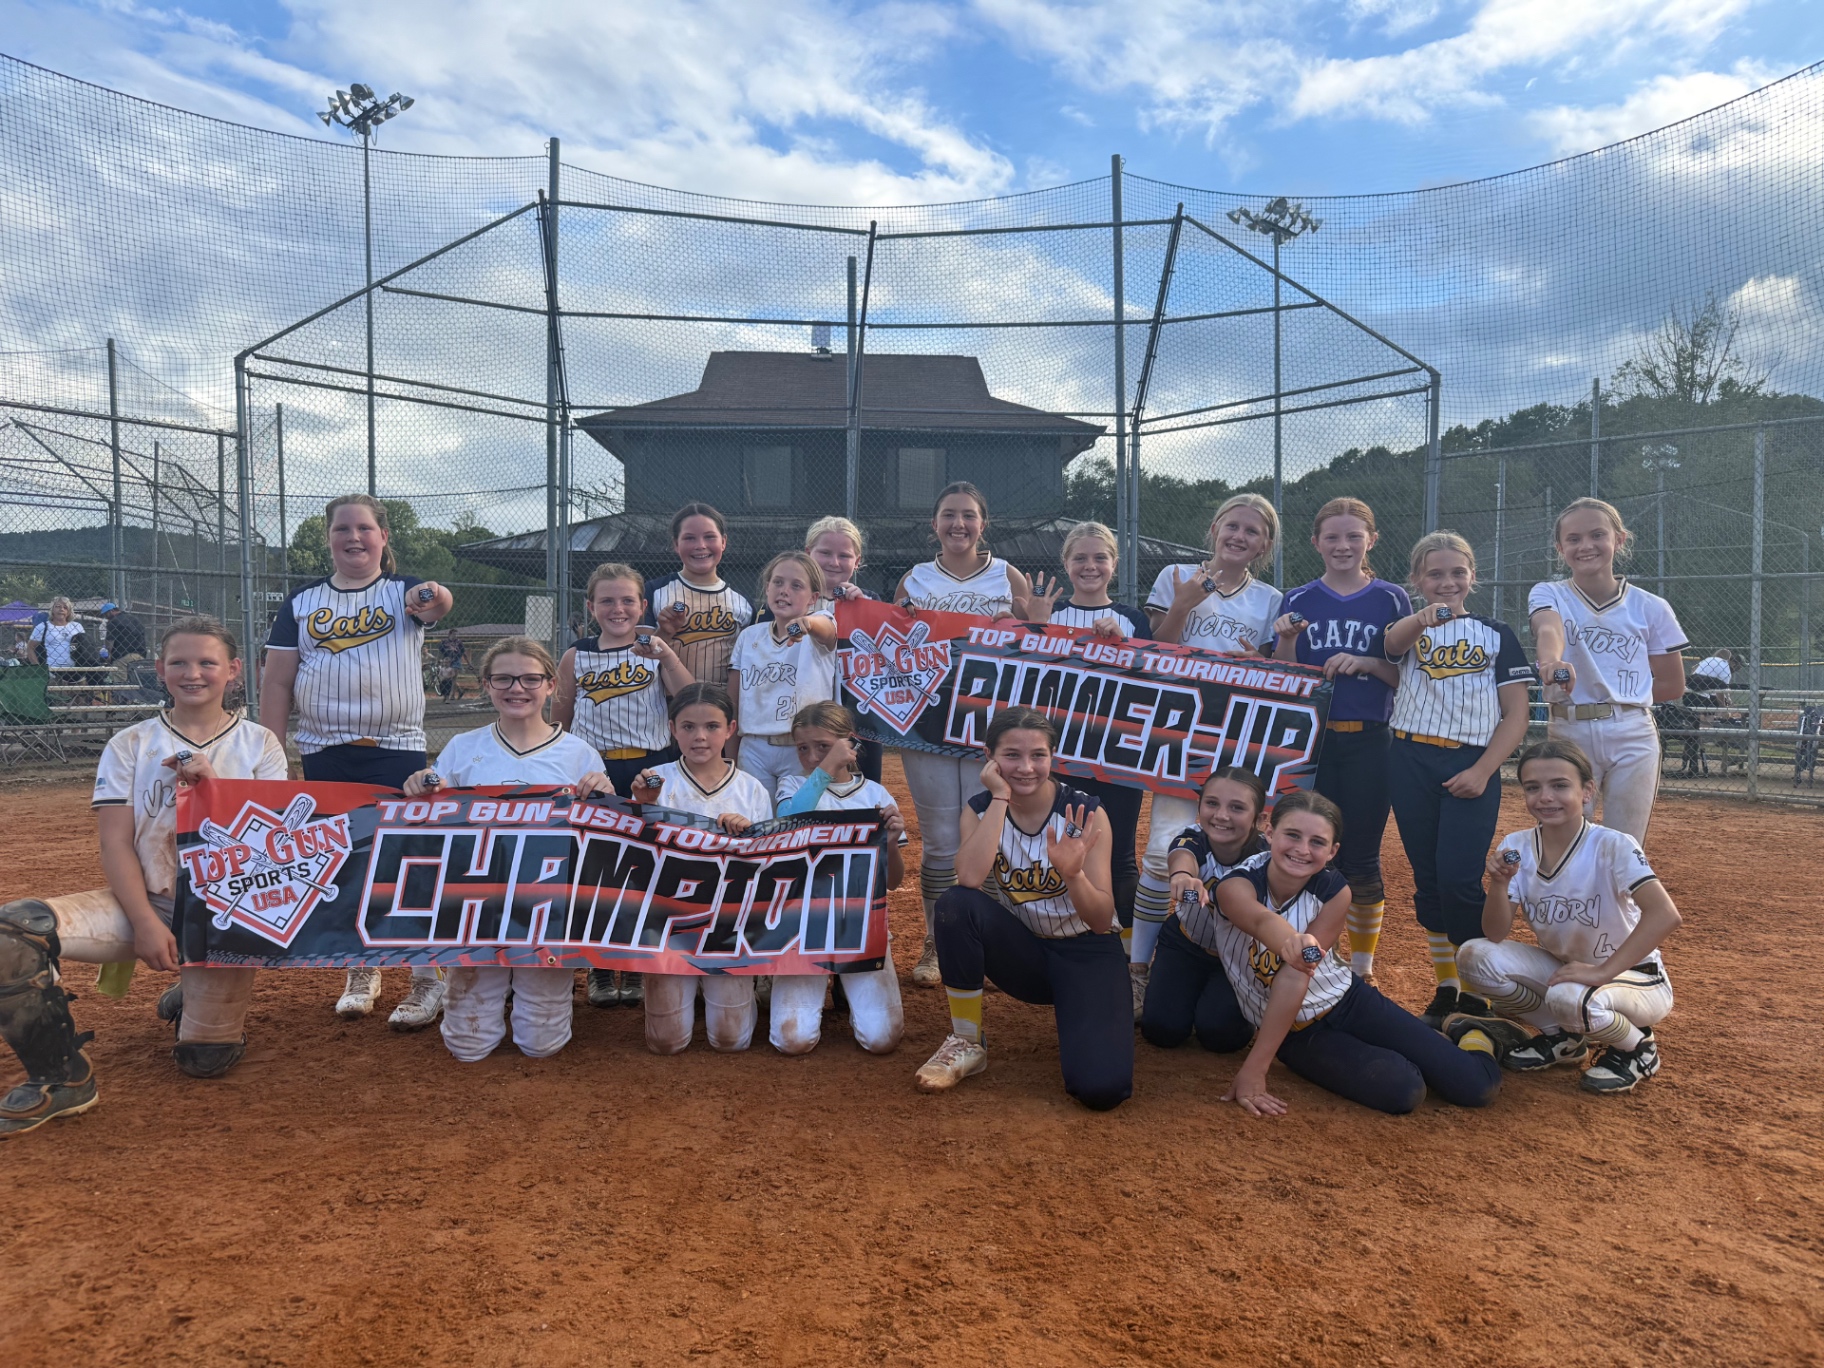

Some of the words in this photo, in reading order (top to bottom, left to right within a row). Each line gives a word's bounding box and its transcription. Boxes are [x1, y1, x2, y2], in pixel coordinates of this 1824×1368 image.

[307, 605, 393, 640] Cats
[1305, 618, 1378, 653] CATS
[838, 650, 886, 681] TOP
[894, 643, 950, 673] GUN
[968, 626, 1016, 647] TOP
[1021, 634, 1136, 669] GUN-USA
[1142, 652, 1321, 697] TOURNAMENT
[1415, 635, 1486, 667] Cats
[870, 673, 922, 691] SPORTS
[884, 690, 915, 706] USA
[1618, 670, 1639, 697] 11
[943, 653, 1320, 799] RUNNER-UP
[379, 801, 460, 822] TOP
[467, 801, 646, 837] GUN-USA
[654, 822, 879, 855] TOURNAMENT
[183, 844, 252, 889] TOP
[265, 818, 351, 865] GUN
[228, 862, 311, 896] SPORTS
[994, 852, 1064, 891] Cats
[251, 885, 299, 912] USA
[356, 826, 880, 958] CHAMPION
[1593, 933, 1617, 958] 4
